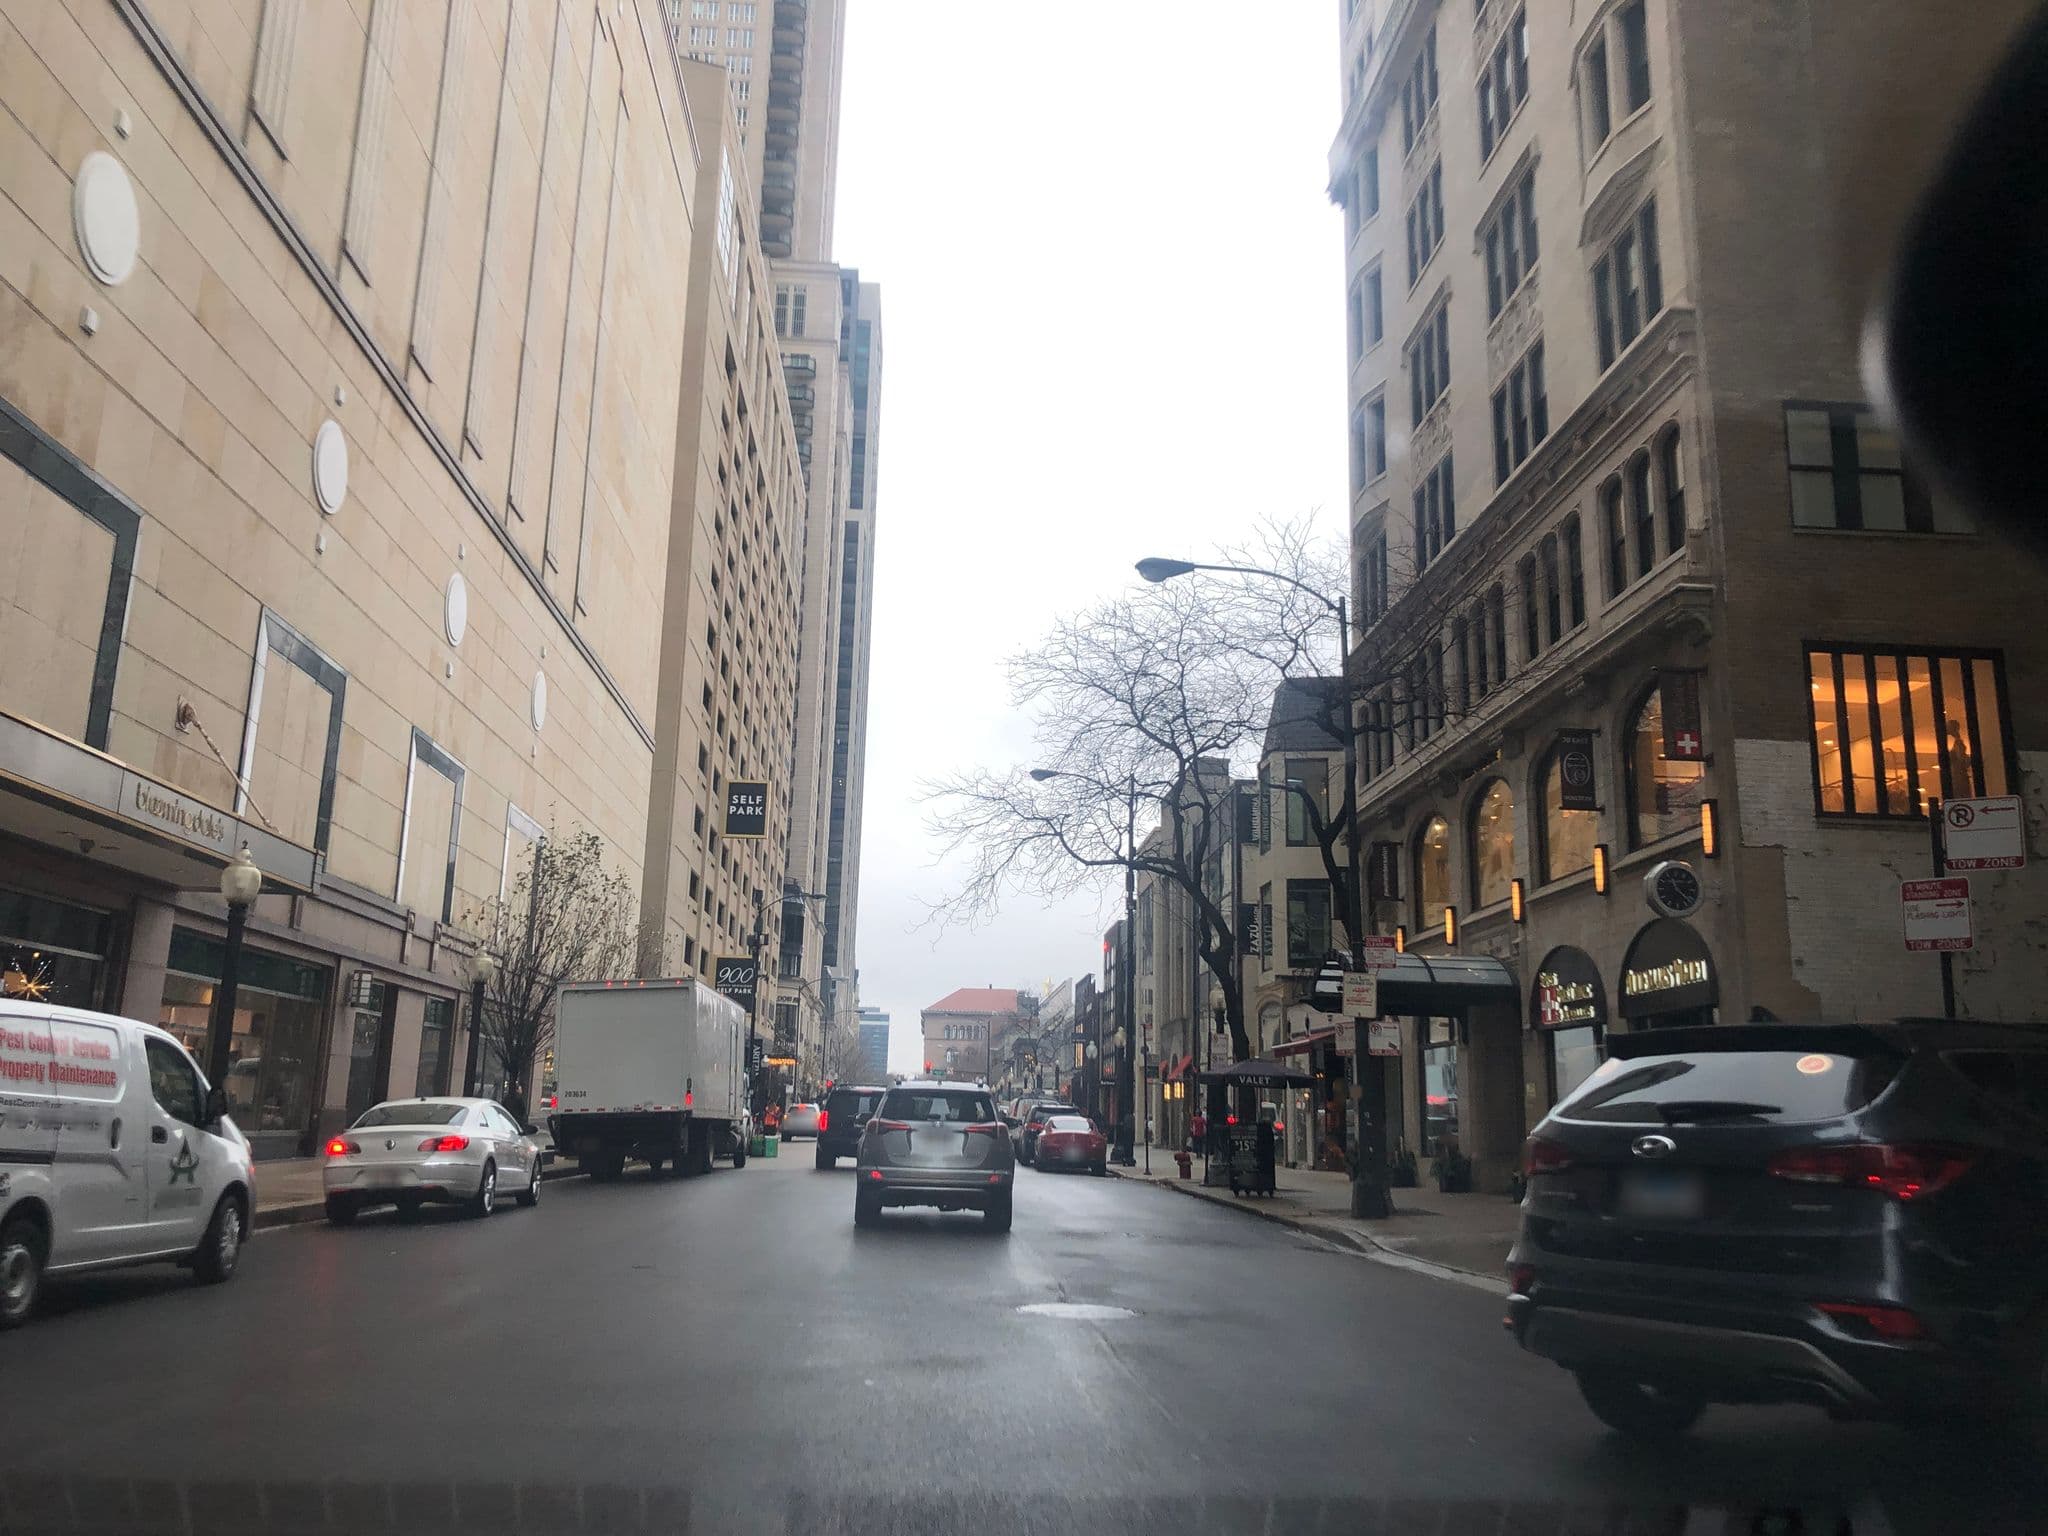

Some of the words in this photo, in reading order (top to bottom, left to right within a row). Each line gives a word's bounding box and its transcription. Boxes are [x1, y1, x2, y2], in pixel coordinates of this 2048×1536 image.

[732, 795, 763, 804] SELF
[729, 806, 763, 815] PARK
[1951, 859, 1977, 869] TOW
[1984, 857, 2017, 868] ZONE
[1909, 941, 1932, 949] TOW
[1937, 939, 1967, 949] ZONE
[717, 966, 754, 984] 900
[48, 1061, 118, 1088] Maintenance
[1239, 1075, 1271, 1084] VALET
